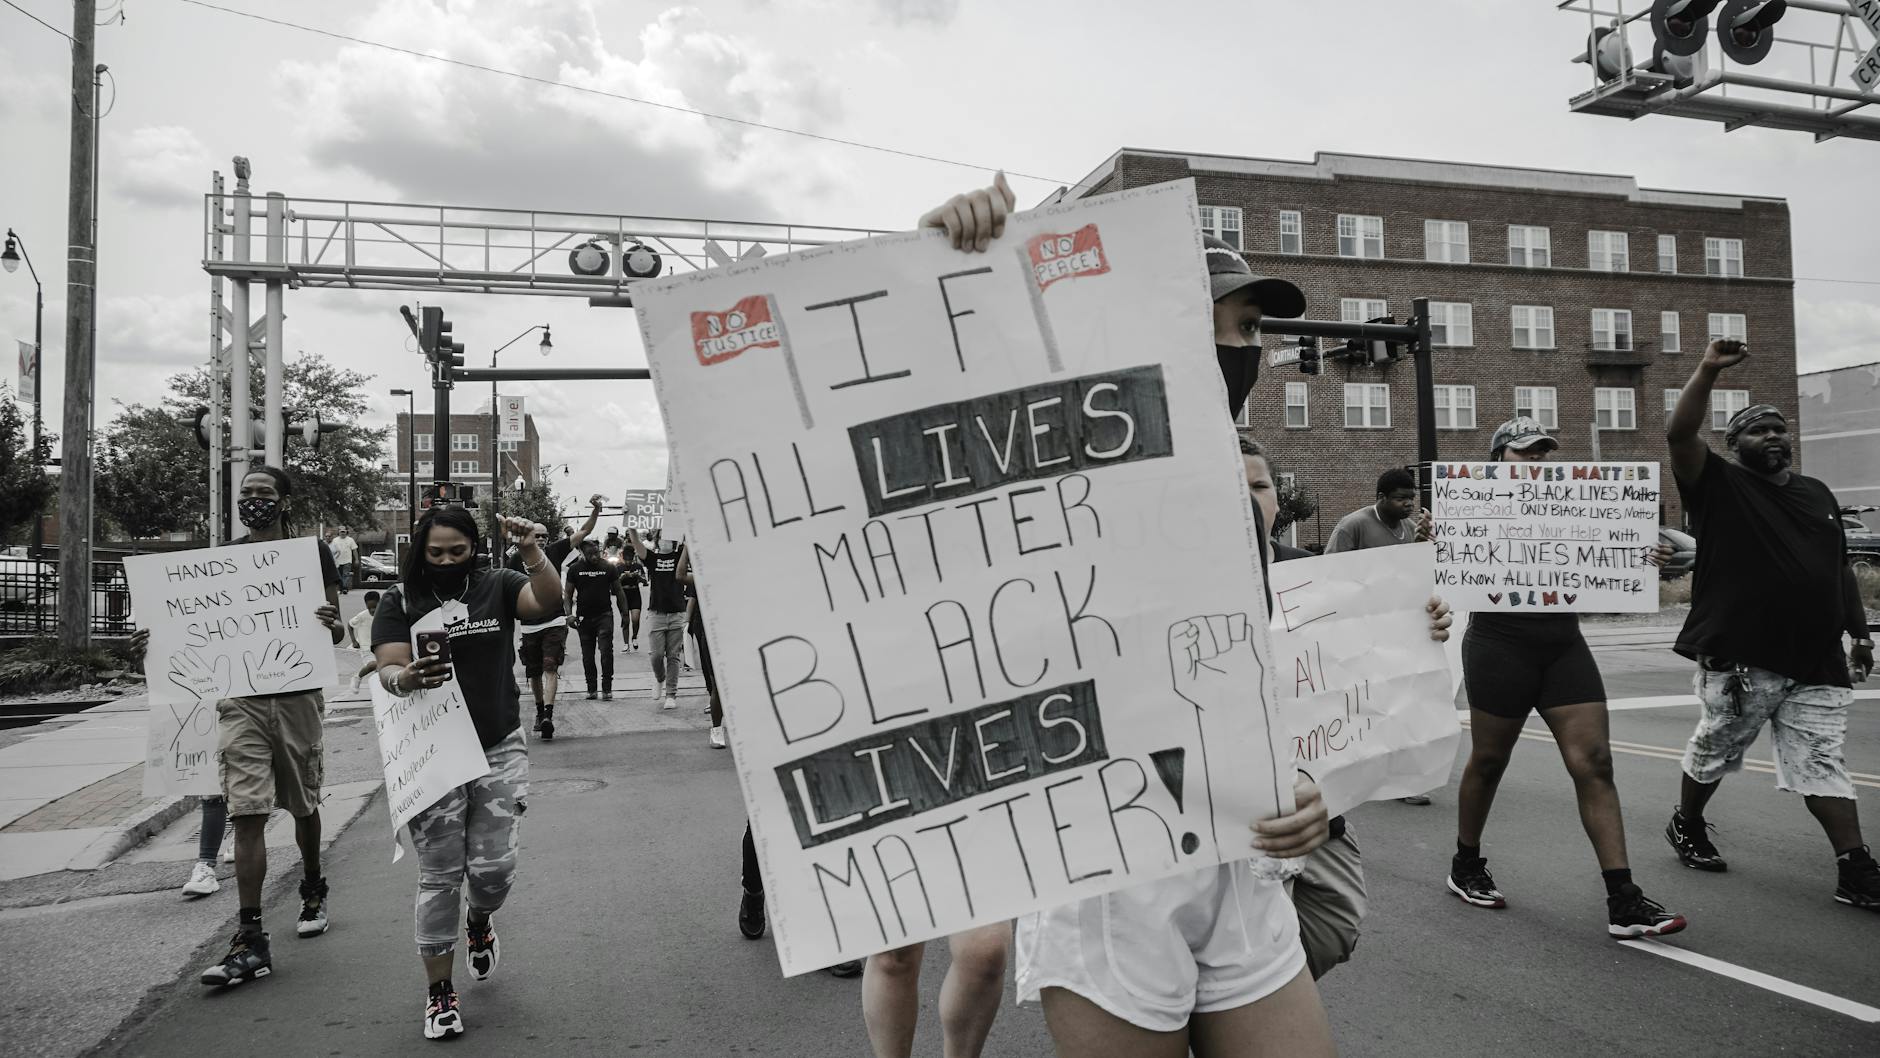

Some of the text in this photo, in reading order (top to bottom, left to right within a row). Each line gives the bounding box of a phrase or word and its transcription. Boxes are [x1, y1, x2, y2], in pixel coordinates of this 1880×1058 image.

[1855, 0, 1880, 32] AIL
[1042, 237, 1072, 256] NO
[1036, 251, 1100, 281] PEACE!
[706, 312, 744, 336] NO
[805, 266, 992, 390] IF
[699, 326, 778, 355] JUSTICE!
[1273, 346, 1302, 363] CARTHAG
[709, 442, 846, 542] ALL
[871, 383, 1136, 499] LIVES
[1436, 464, 1652, 482] BLACK LIVES MATTER
[1434, 481, 1660, 502] We Said BLACK LIVES Matter
[1437, 501, 1482, 518] Never
[1485, 501, 1514, 517] Said
[1521, 503, 1549, 516] ONLY
[1589, 507, 1622, 520] LIVES
[1623, 506, 1658, 520] Matter
[813, 474, 1102, 611] MATTER
[1434, 521, 1457, 537] We
[1460, 522, 1488, 538] Just
[1498, 523, 1533, 539] Need
[1538, 523, 1564, 539] Your
[1570, 524, 1601, 542] Help
[165, 550, 280, 583] HANDS UP
[1433, 540, 1658, 571] BLACK LIVES MATTER
[1434, 569, 1457, 585] We
[1503, 569, 1534, 587] ALL
[1538, 569, 1581, 589] LIVES
[166, 576, 307, 617] MEANS DON'T
[185, 605, 299, 648] SHOOT!!!
[446, 618, 500, 634] mhouse
[758, 565, 1121, 745] BLACK
[792, 693, 1088, 836] LIVES
[813, 746, 1200, 953] MATTER!
